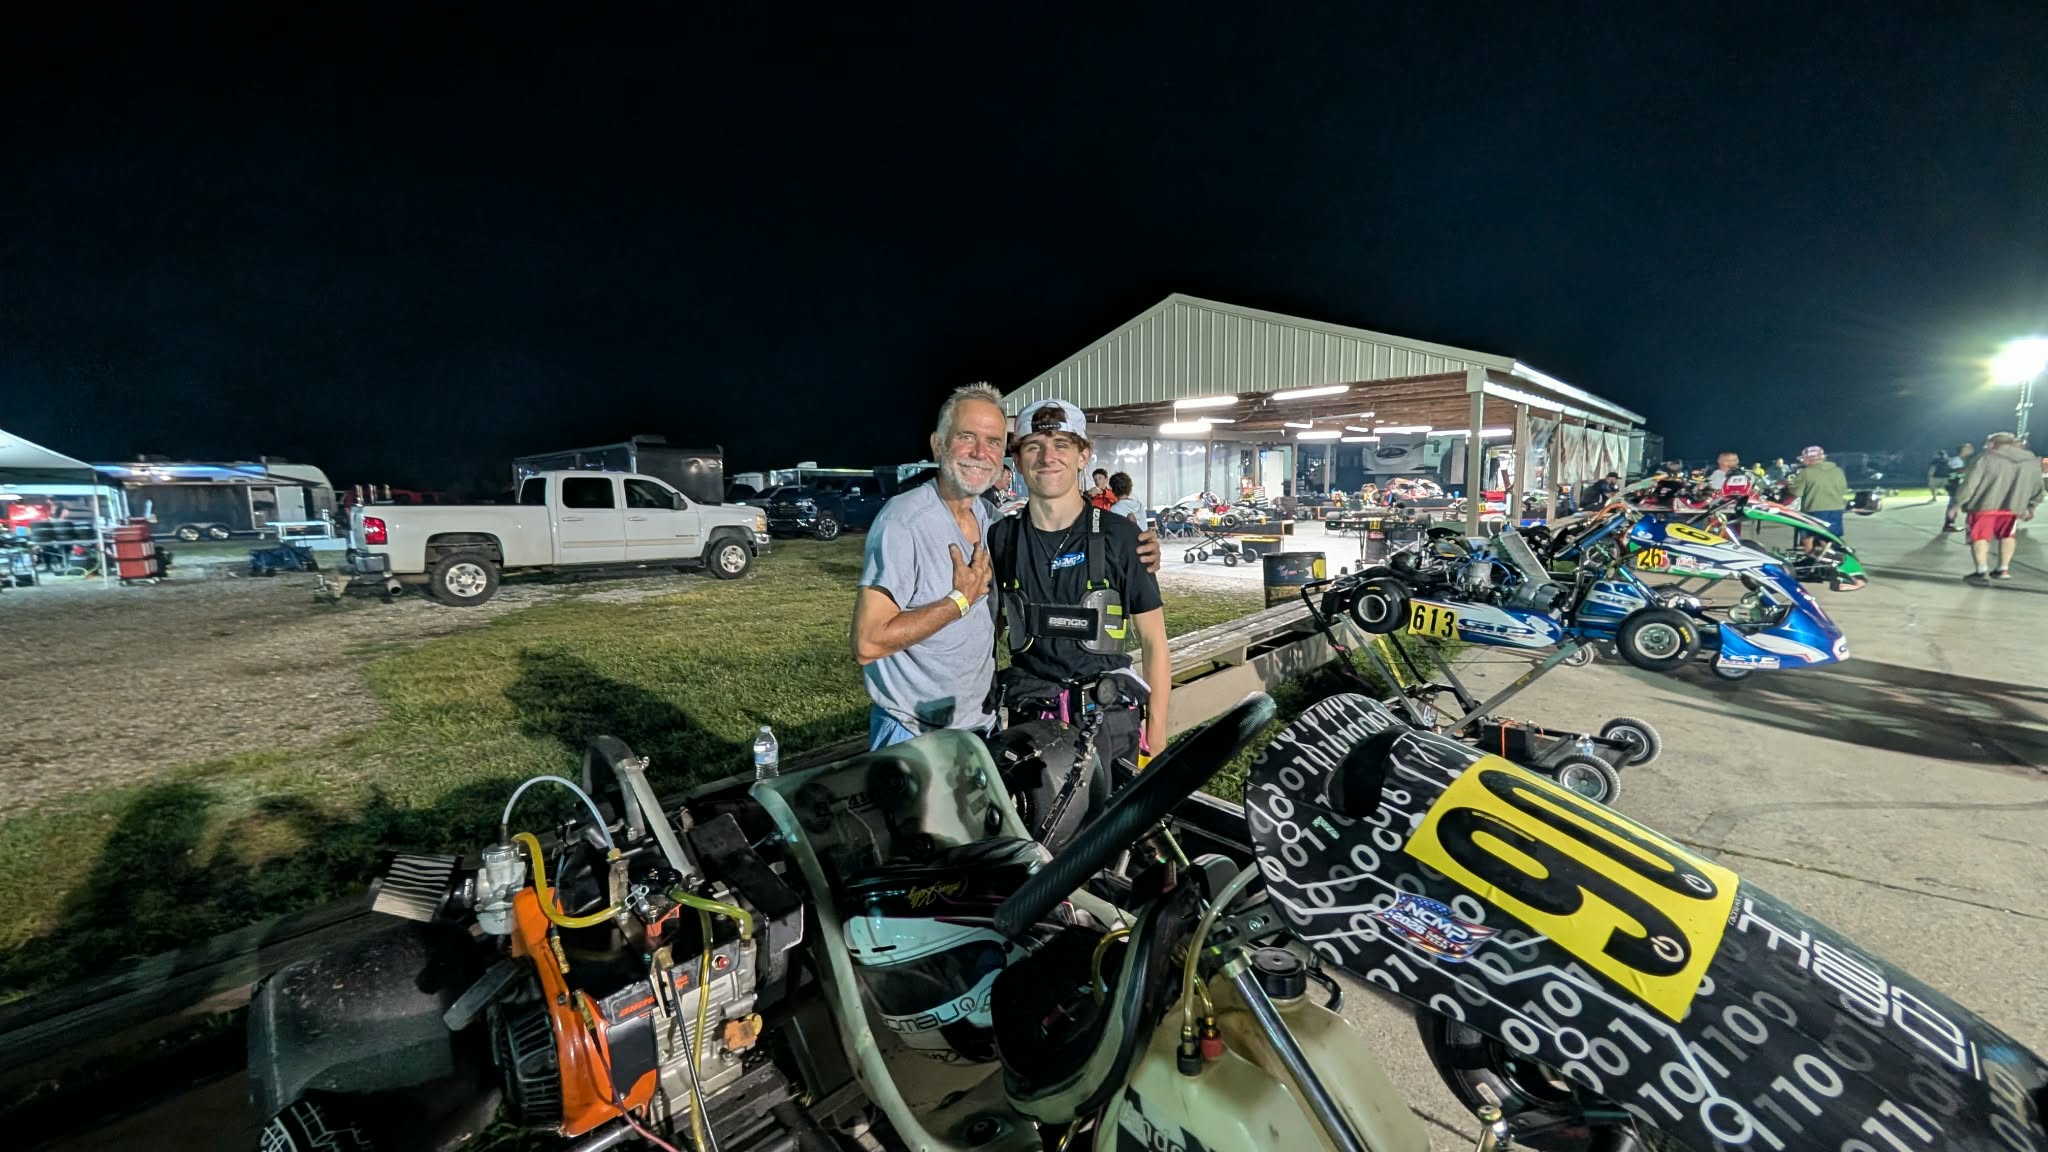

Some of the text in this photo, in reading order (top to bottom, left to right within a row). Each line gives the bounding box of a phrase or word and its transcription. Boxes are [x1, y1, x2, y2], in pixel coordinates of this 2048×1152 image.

[1640, 546, 1662, 567] 26
[1048, 617, 1088, 627] BENGIO
[1413, 605, 1454, 638] 613
[1436, 770, 1718, 976] 90
[1392, 912, 1427, 935] 2026
[1405, 902, 1469, 940] NCMP
